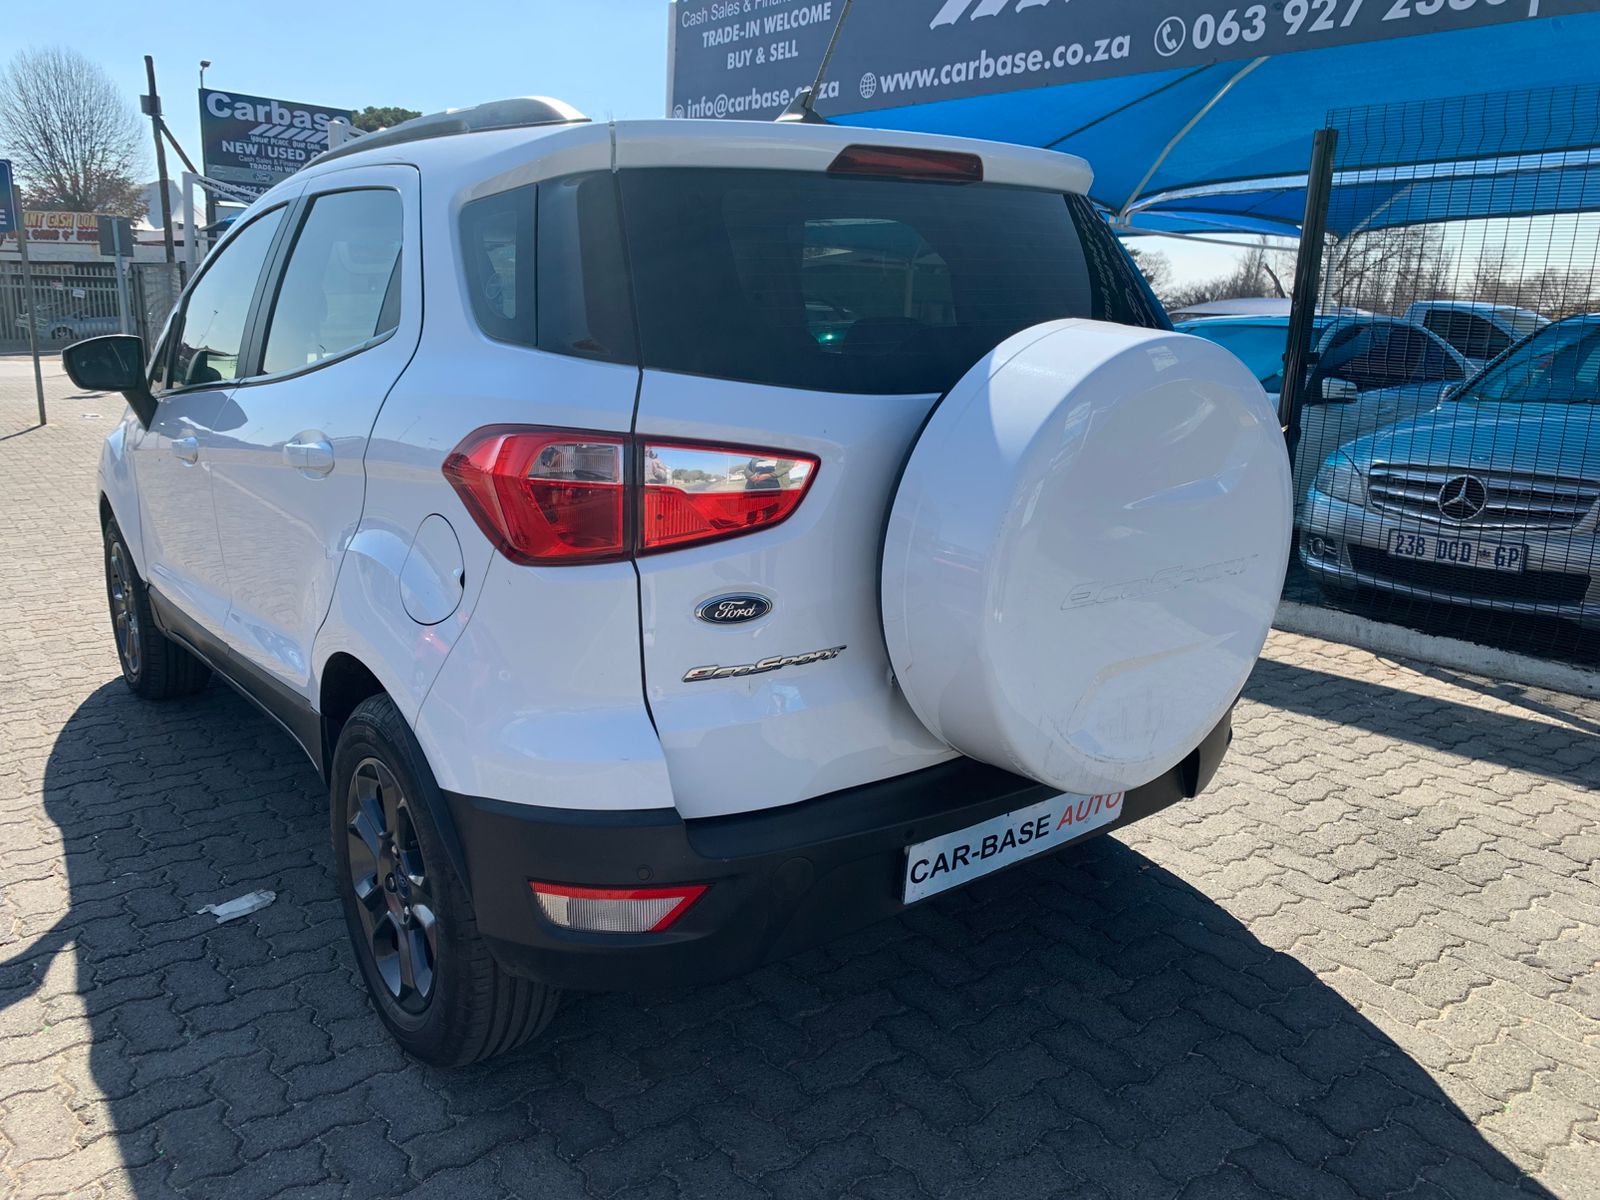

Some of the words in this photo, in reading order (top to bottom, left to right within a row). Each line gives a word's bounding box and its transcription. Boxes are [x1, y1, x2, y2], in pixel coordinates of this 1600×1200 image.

[682, 8, 708, 27] Cash
[711, 1, 740, 20] Sales
[743, 0, 750, 12] &
[702, 20, 760, 47] TRADE-IN
[764, 2, 832, 34] WELCOME
[1192, 10, 1266, 50] 063
[1283, 0, 1363, 35] 927
[727, 49, 752, 70] BUY
[755, 48, 765, 65] &
[770, 40, 799, 61] SELL
[880, 35, 1131, 93] www.carbase.co.za
[221, 140, 258, 155] NEW
[268, 148, 305, 161] USED
[47, 213, 73, 228] CASH
[1494, 546, 1519, 567] GP
[714, 601, 756, 618] Ford
[910, 814, 1051, 884] CAR-BASE
[1056, 792, 1122, 831] AUTO
